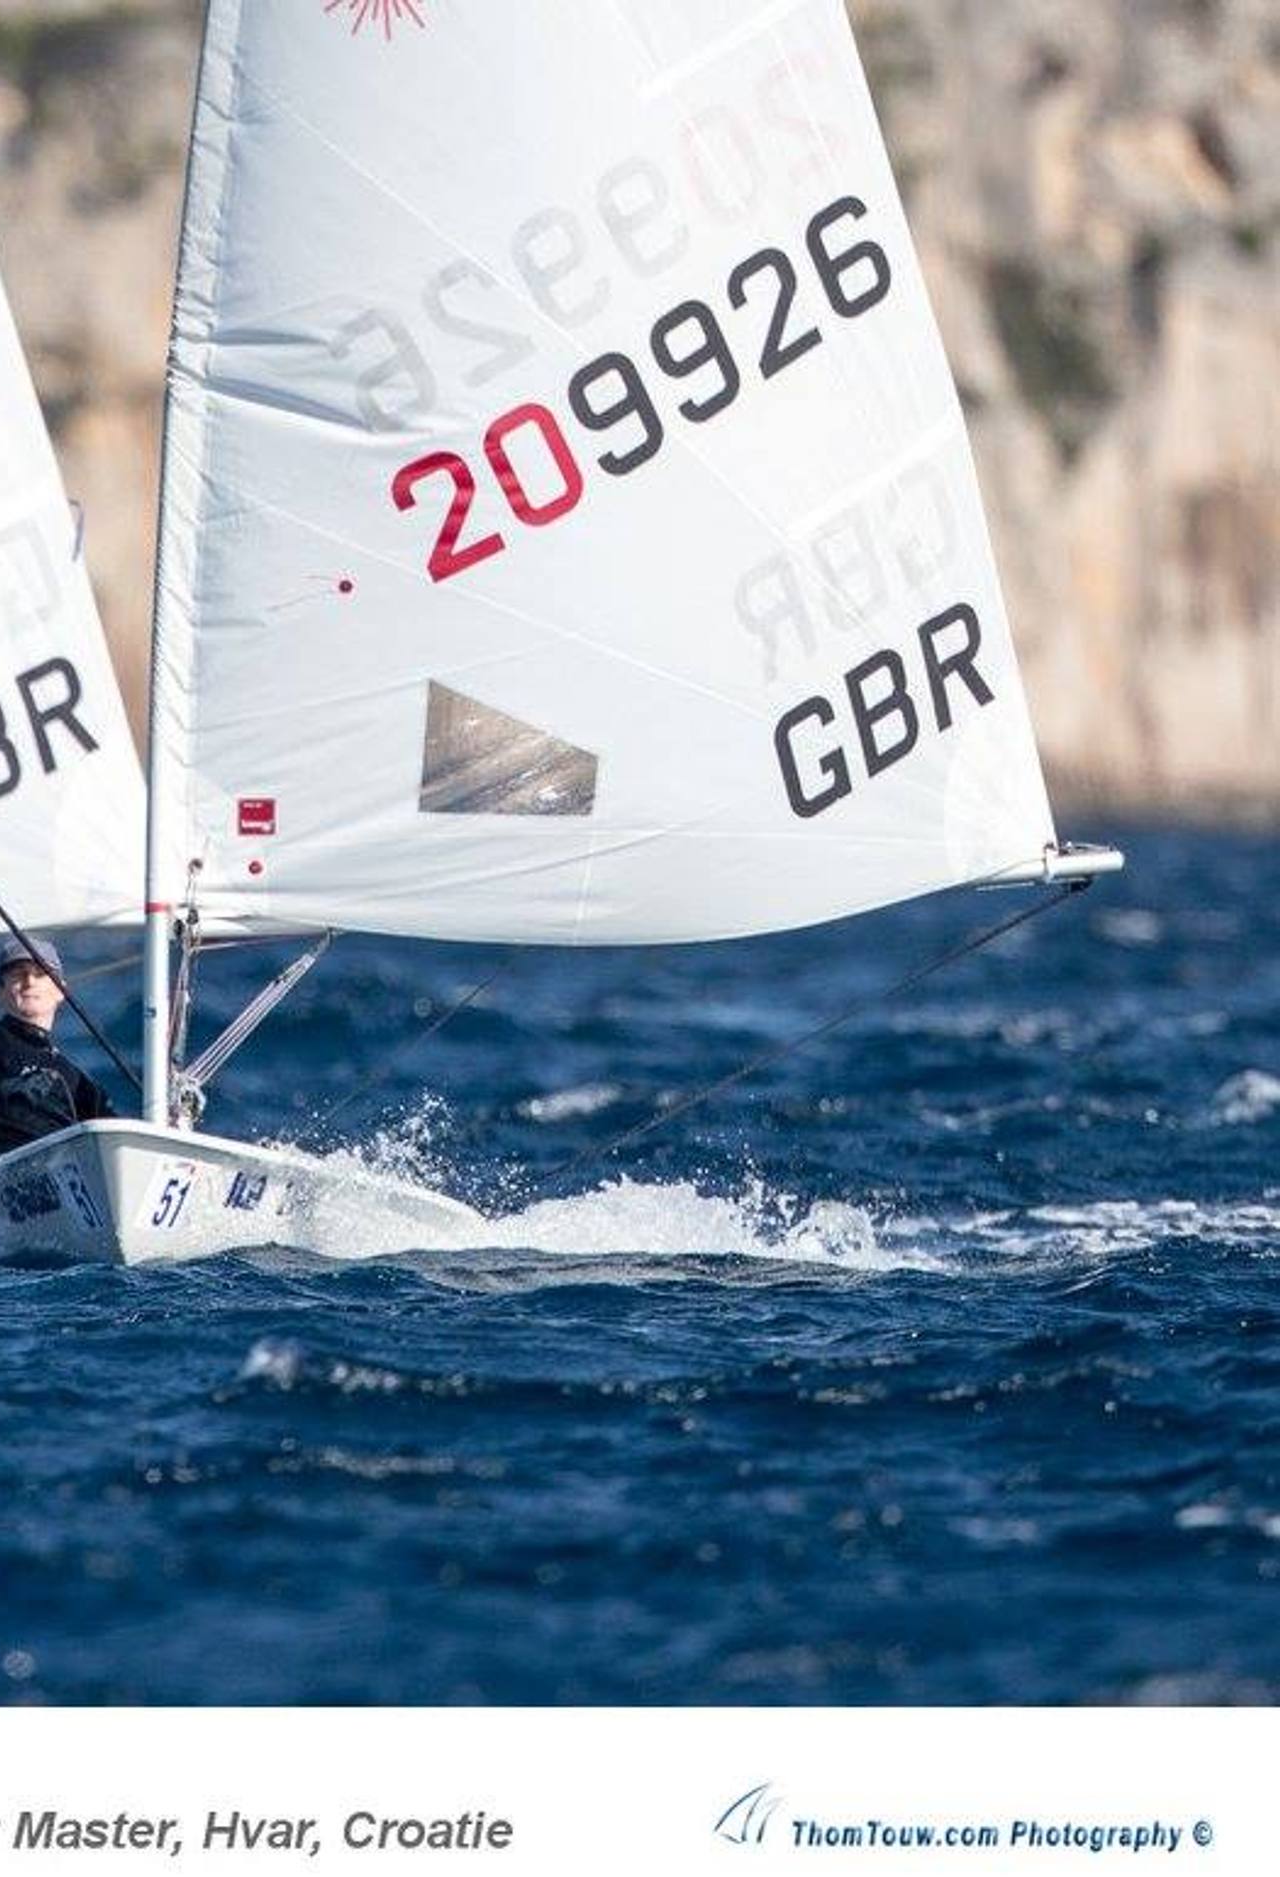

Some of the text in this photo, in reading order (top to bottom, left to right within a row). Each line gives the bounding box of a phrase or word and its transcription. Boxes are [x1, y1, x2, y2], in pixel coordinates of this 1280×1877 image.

[391, 195, 892, 583] 209926
[774, 602, 995, 819] GBR
[151, 1178, 191, 1228] 51
